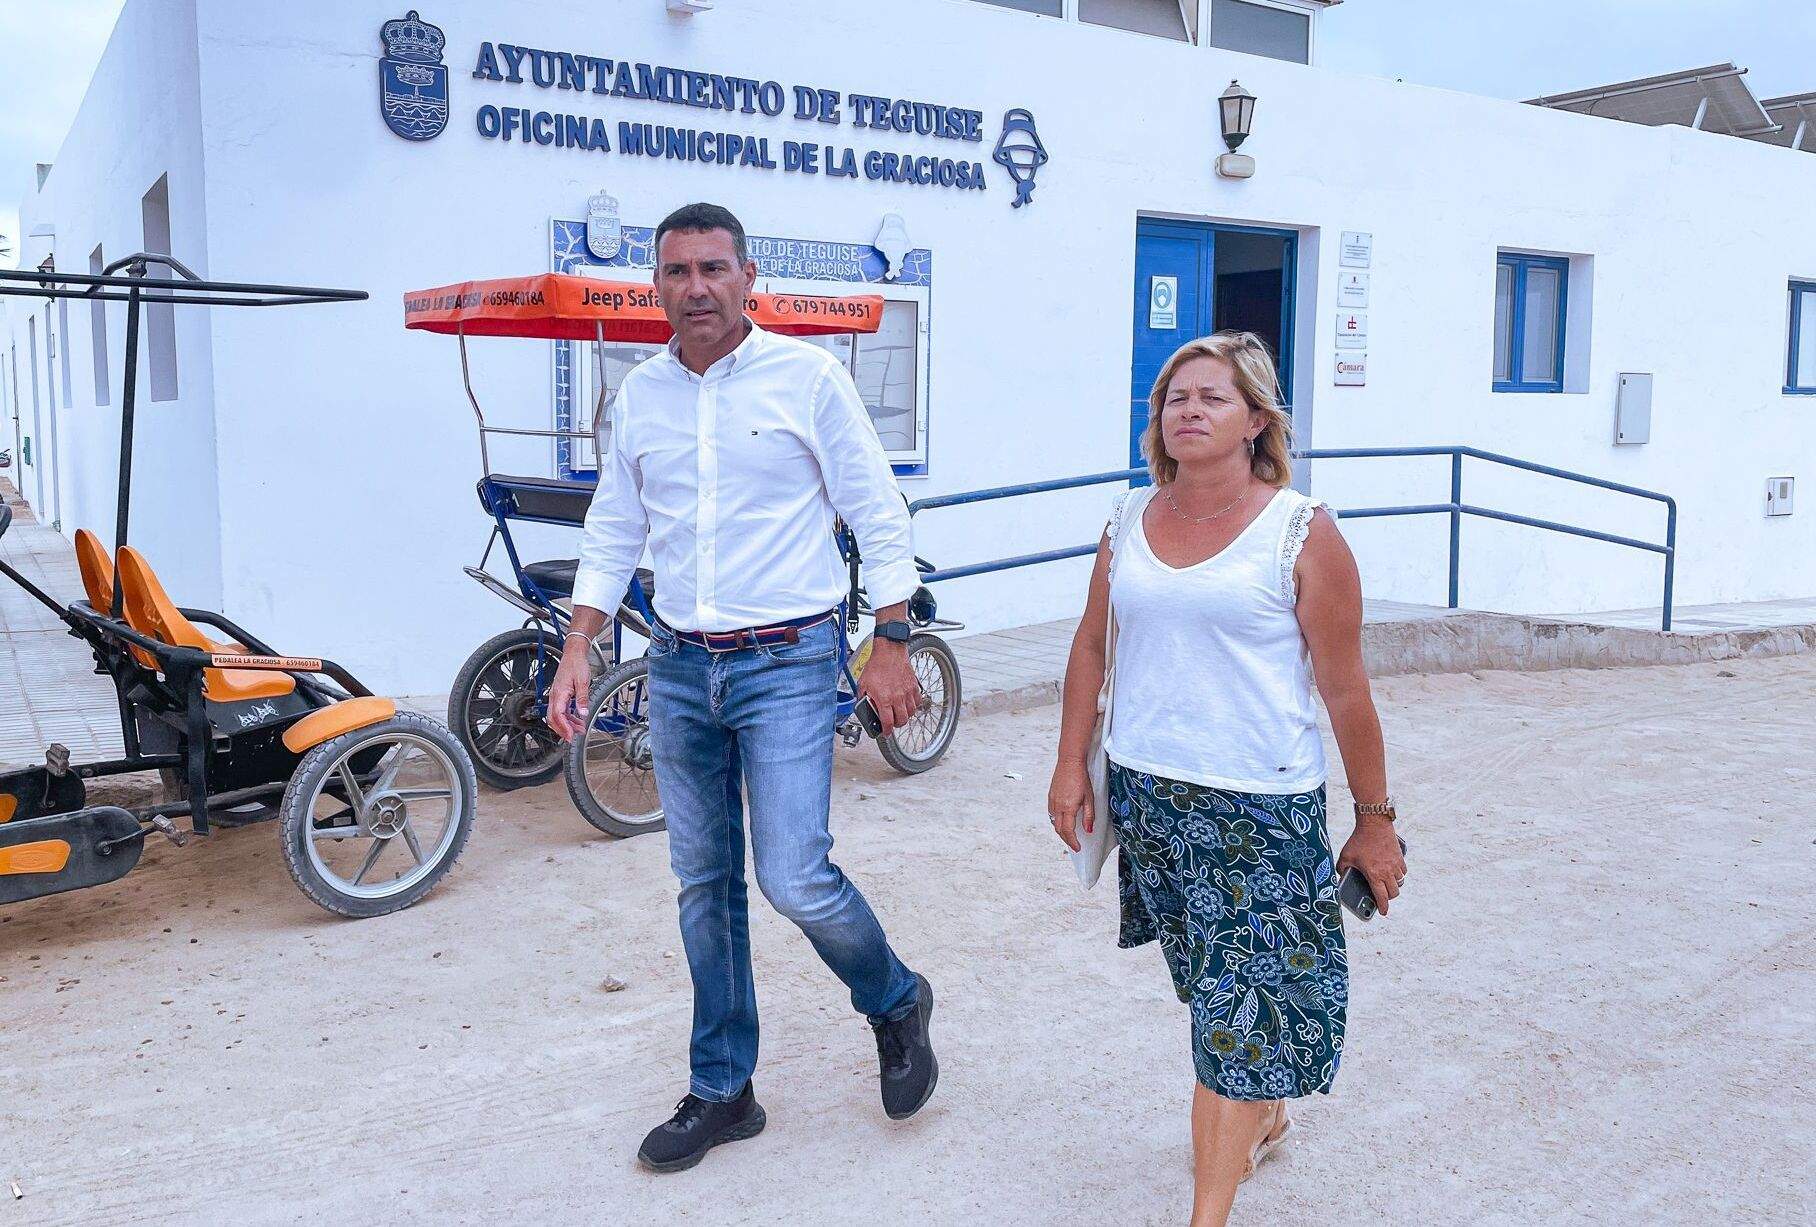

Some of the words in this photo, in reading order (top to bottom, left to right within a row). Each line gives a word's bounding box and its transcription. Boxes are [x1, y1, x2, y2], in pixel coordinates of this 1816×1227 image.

[472, 41, 785, 117] AYUNTAMIENTO
[793, 85, 841, 125] DE
[849, 93, 983, 142] TEGUISE
[476, 104, 611, 152] OFICINA
[618, 121, 777, 169] MUNICIPAL
[783, 140, 819, 174] DE
[825, 145, 859, 179] LA
[863, 150, 987, 190] GRACIOSA
[746, 238, 772, 256] NTO
[777, 240, 795, 258] DE
[800, 242, 858, 261] TEGUISE
[771, 258, 784, 272] DE
[788, 260, 802, 273] LA
[805, 260, 859, 276] GRACIOSA
[490, 290, 545, 306] 659460184
[581, 287, 624, 311] Jeep
[627, 289, 661, 308] Safa
[743, 298, 758, 311] ro
[792, 299, 870, 319] 679744951
